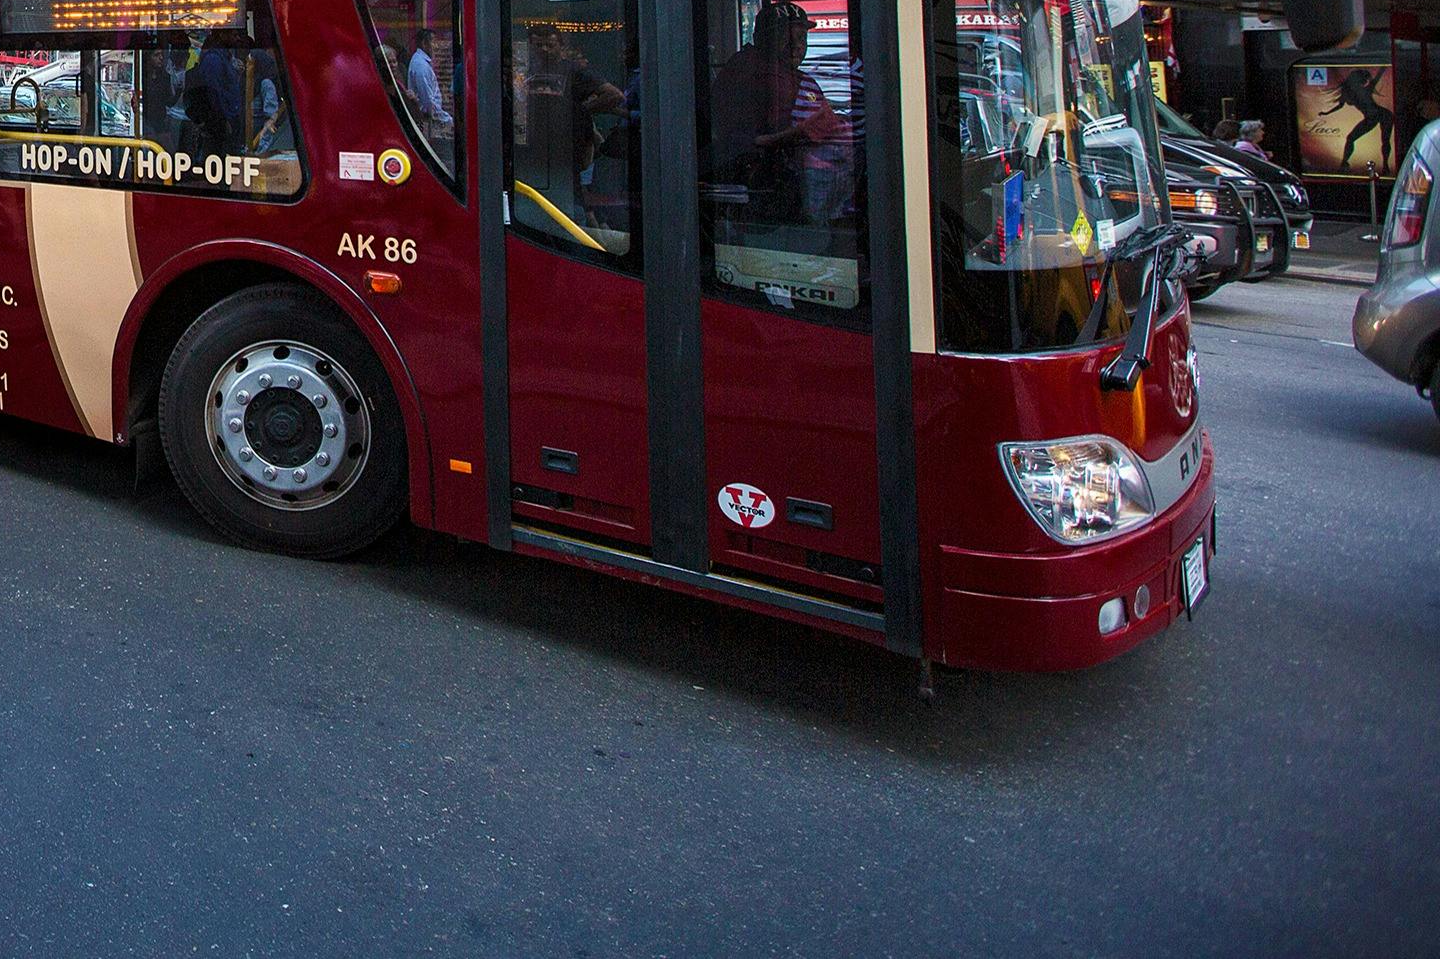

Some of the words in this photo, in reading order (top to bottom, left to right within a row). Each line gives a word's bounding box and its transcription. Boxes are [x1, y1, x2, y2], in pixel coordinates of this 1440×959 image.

[1311, 69, 1324, 81] A
[1303, 120, 1341, 135] Lace
[21, 143, 112, 176] HOP-ON
[137, 150, 261, 187] HOP-OFF
[337, 232, 376, 260] AK
[384, 236, 418, 264] 86
[727, 502, 766, 518] VECTOR
